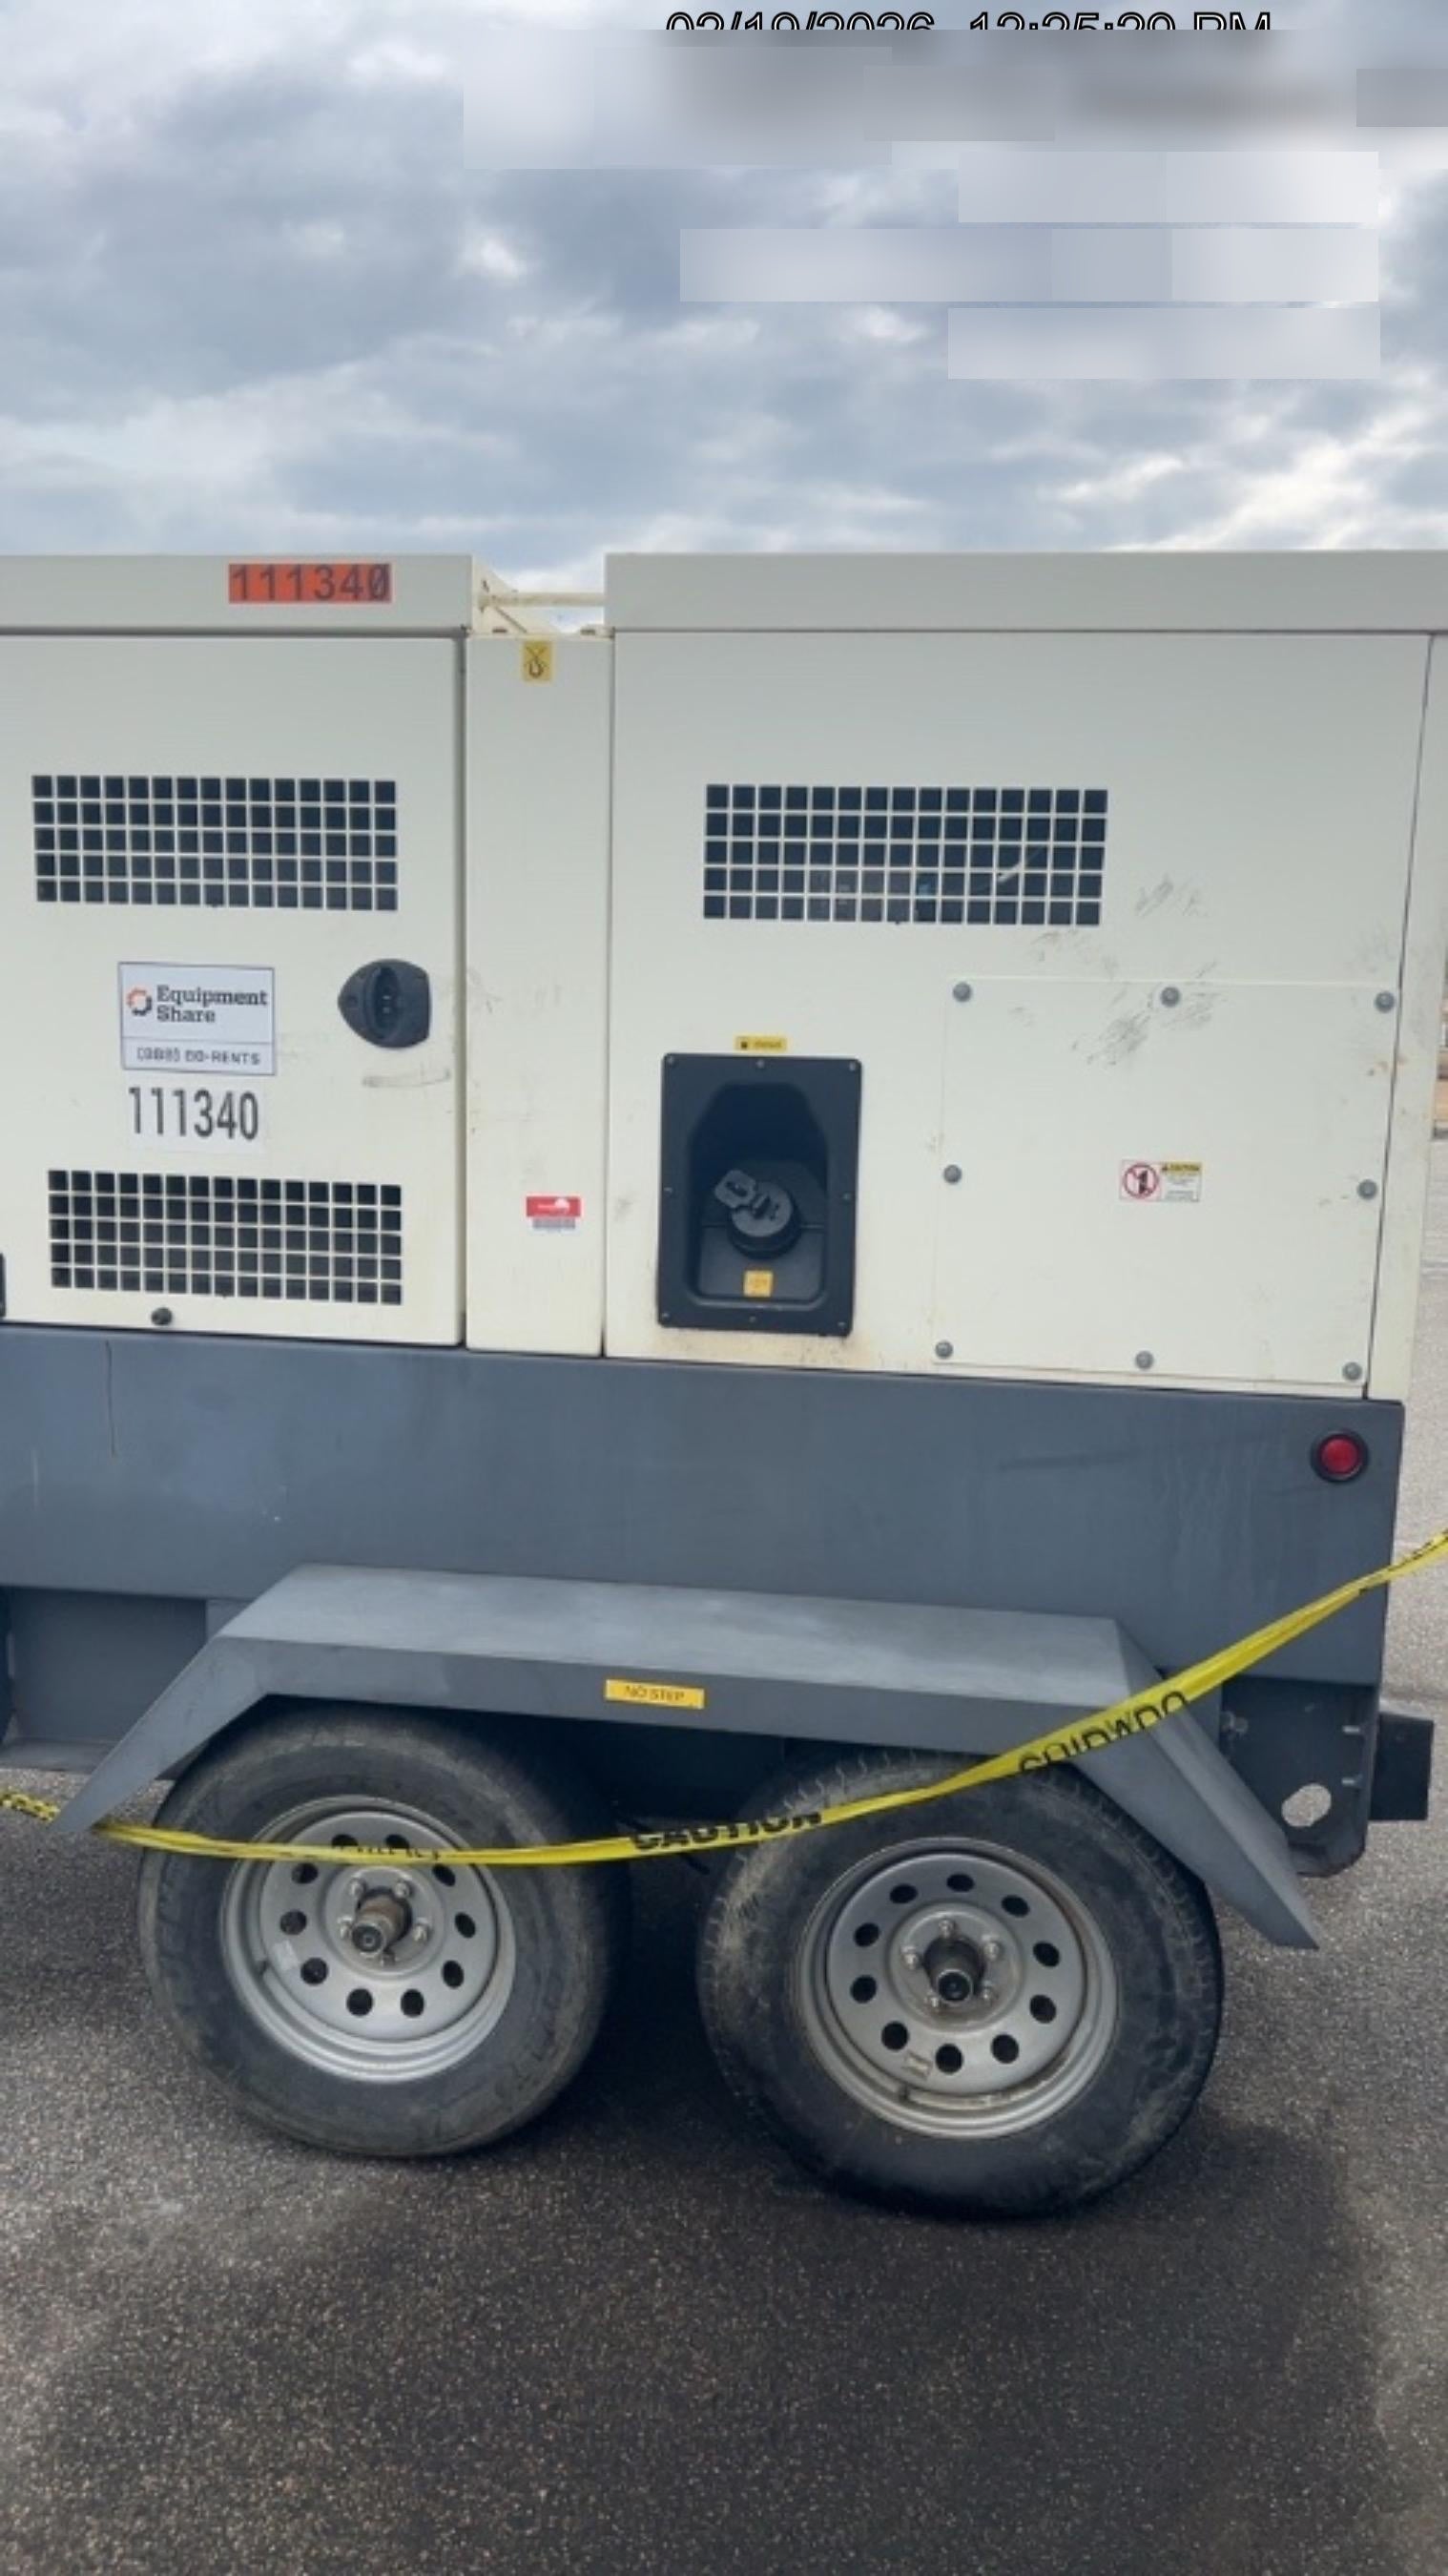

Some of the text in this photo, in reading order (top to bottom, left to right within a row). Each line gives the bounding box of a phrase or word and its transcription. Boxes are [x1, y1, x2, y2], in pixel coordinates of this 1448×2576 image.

[232, 564, 390, 601] 111340
[156, 985, 268, 1008] Equipment
[156, 1005, 217, 1023] Share
[128, 1086, 259, 1141] 111340
[625, 1685, 686, 1702] NO STEP
